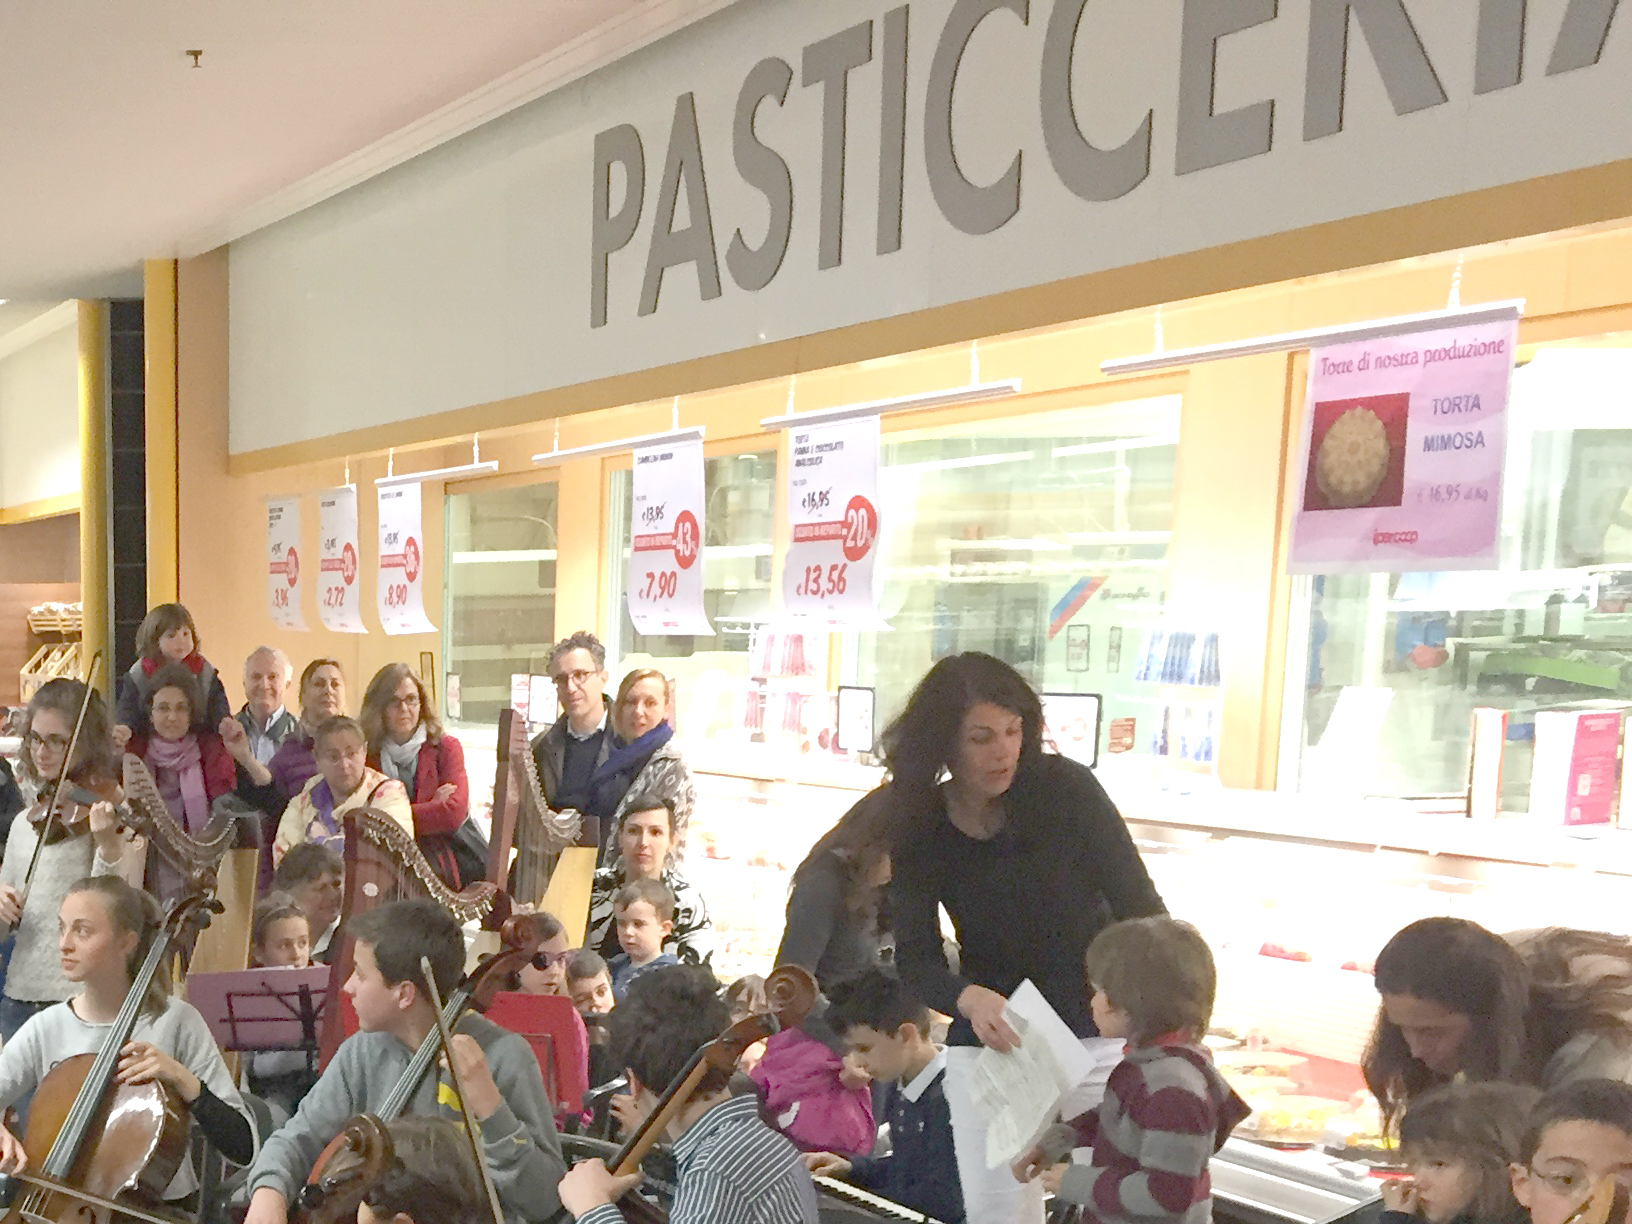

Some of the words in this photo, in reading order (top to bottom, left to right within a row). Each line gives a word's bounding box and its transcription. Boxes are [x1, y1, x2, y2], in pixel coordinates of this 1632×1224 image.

[590, 0, 1620, 328] PASTICCE
[1357, 351, 1369, 371] di
[1374, 350, 1419, 370] nostra
[1423, 337, 1505, 368] produzione
[1432, 395, 1482, 415] TORTA
[1423, 431, 1486, 452] MIMOSA
